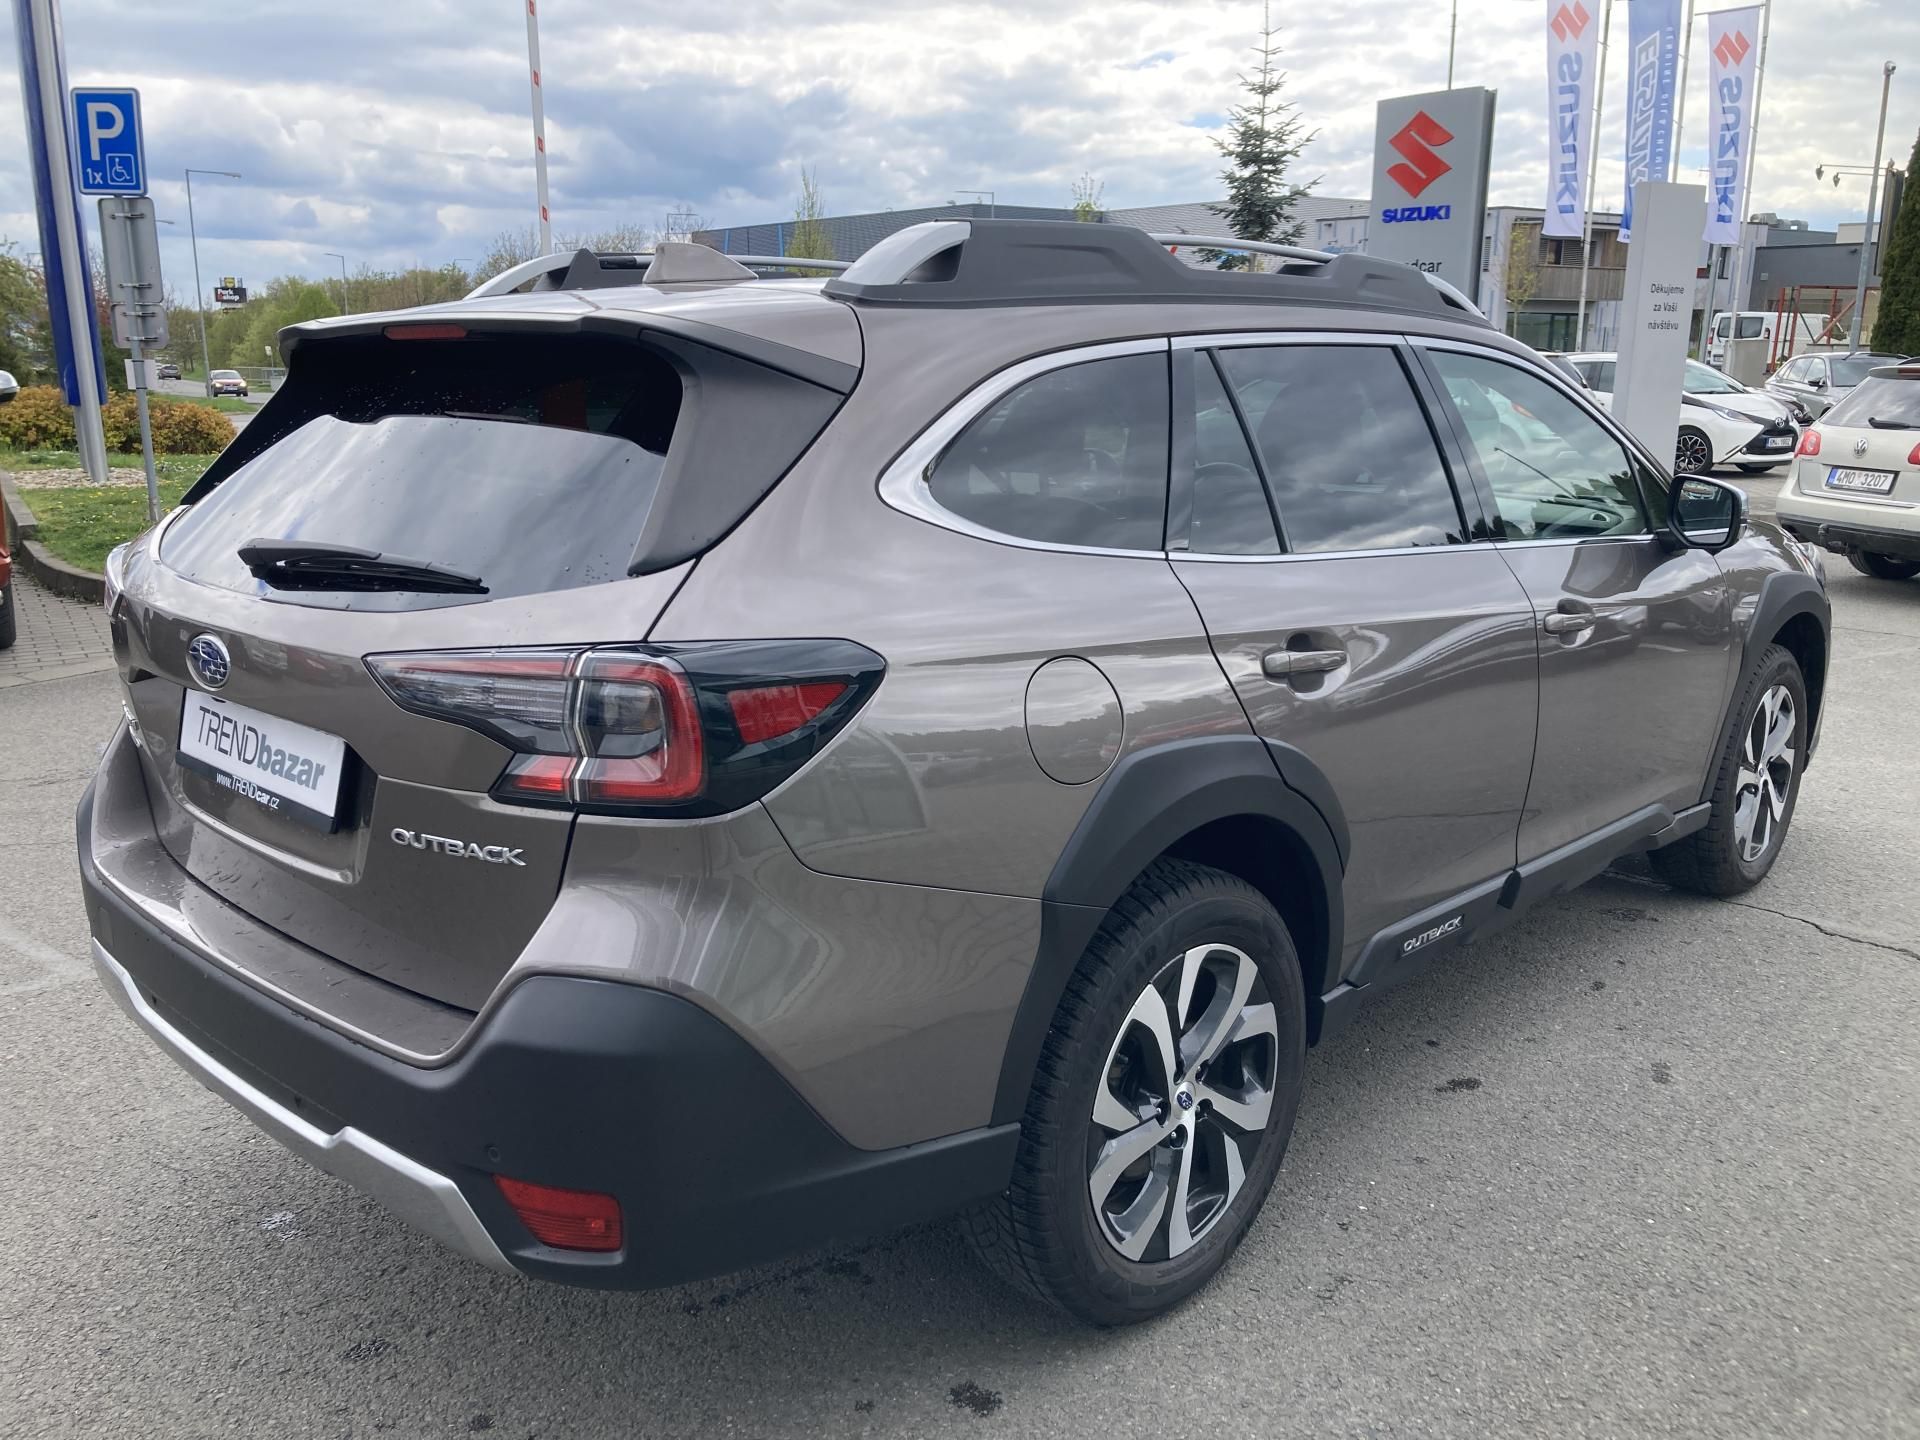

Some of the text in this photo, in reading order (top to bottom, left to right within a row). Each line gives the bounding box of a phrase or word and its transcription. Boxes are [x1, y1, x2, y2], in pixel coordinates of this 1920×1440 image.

[86, 102, 124, 160] P
[86, 168, 103, 184] 1x
[1382, 205, 1451, 223] SUZUKI
[1405, 259, 1442, 273] dcar
[1650, 283, 1685, 296] Děkujeme
[1653, 304, 1661, 312] za
[1861, 473, 1889, 488] 3207
[198, 706, 326, 791] TRENDbazar
[216, 772, 280, 810] www.TRENDcar.cz
[391, 827, 527, 866] OUTBACK
[1403, 916, 1462, 952] OUTBACK
